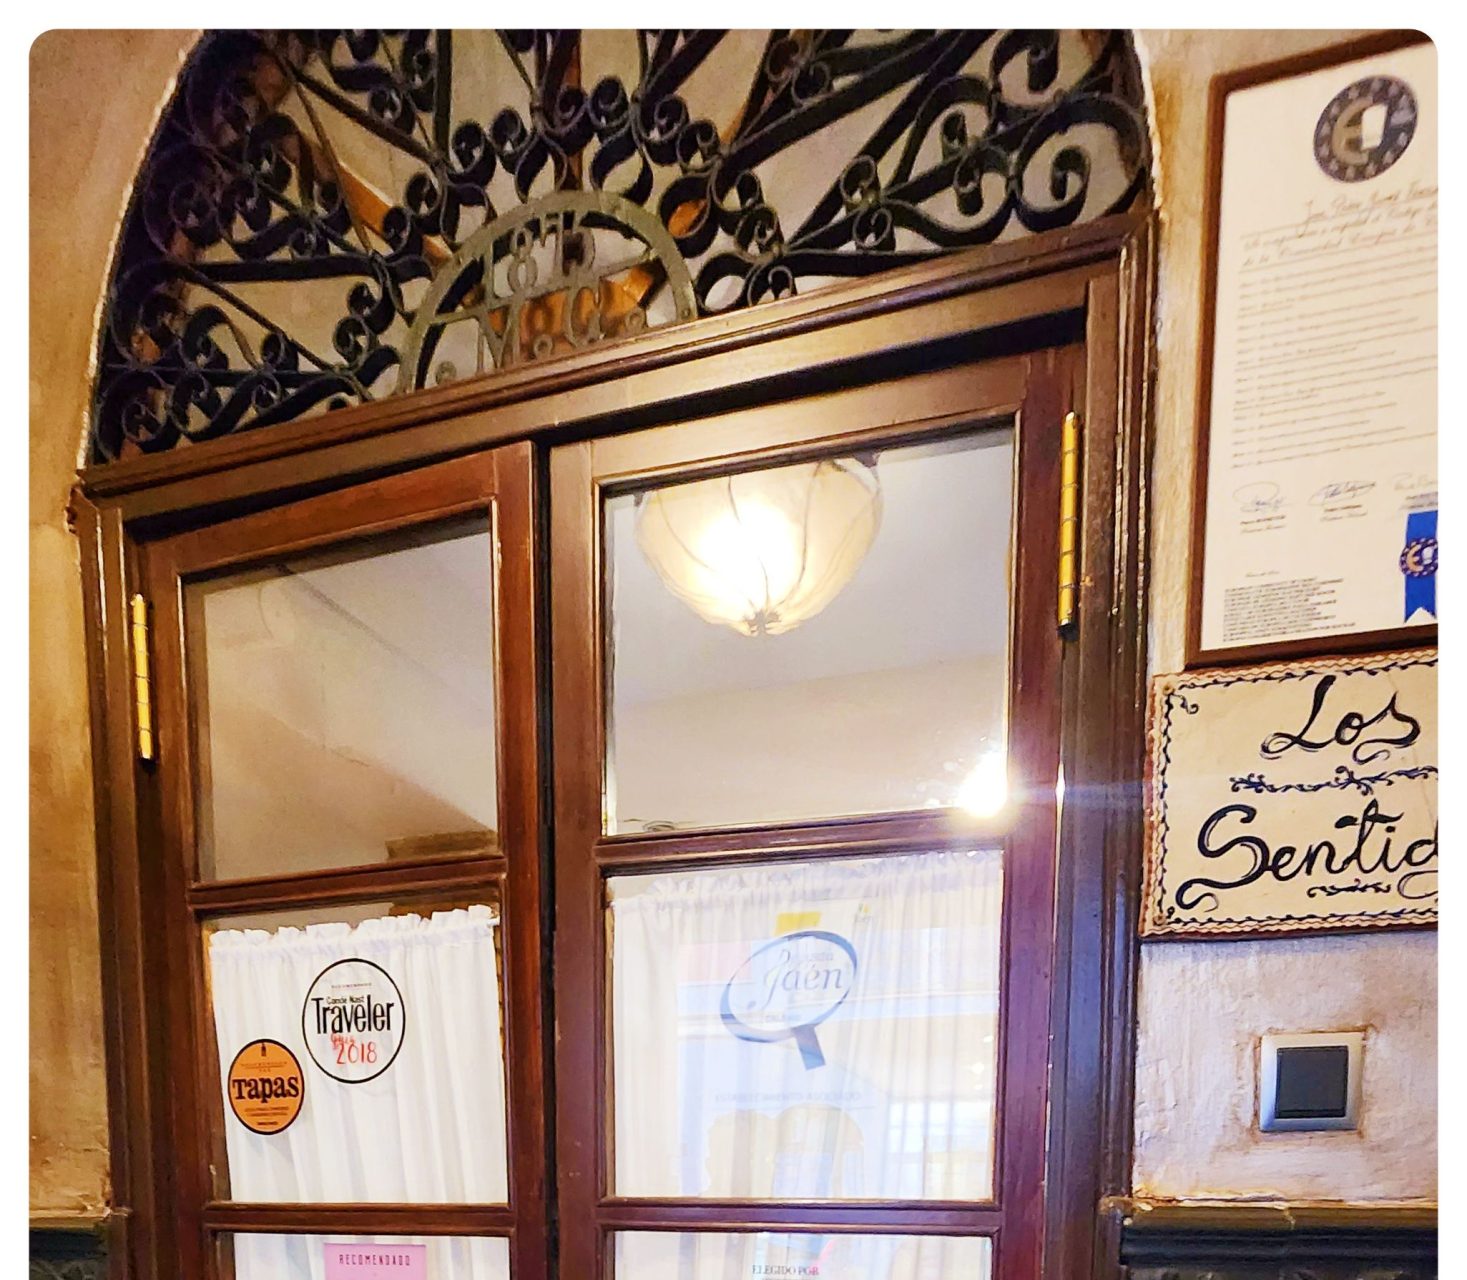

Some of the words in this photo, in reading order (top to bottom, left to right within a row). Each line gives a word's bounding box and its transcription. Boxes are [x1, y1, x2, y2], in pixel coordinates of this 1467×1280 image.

[1259, 674, 1421, 765] Los
[311, 994, 395, 1035] Traveler
[336, 1041, 378, 1065] 2018
[231, 1076, 300, 1104] Tapas
[339, 1254, 412, 1267] RECOMENDADO
[752, 1264, 796, 1276] ELEGIDO
